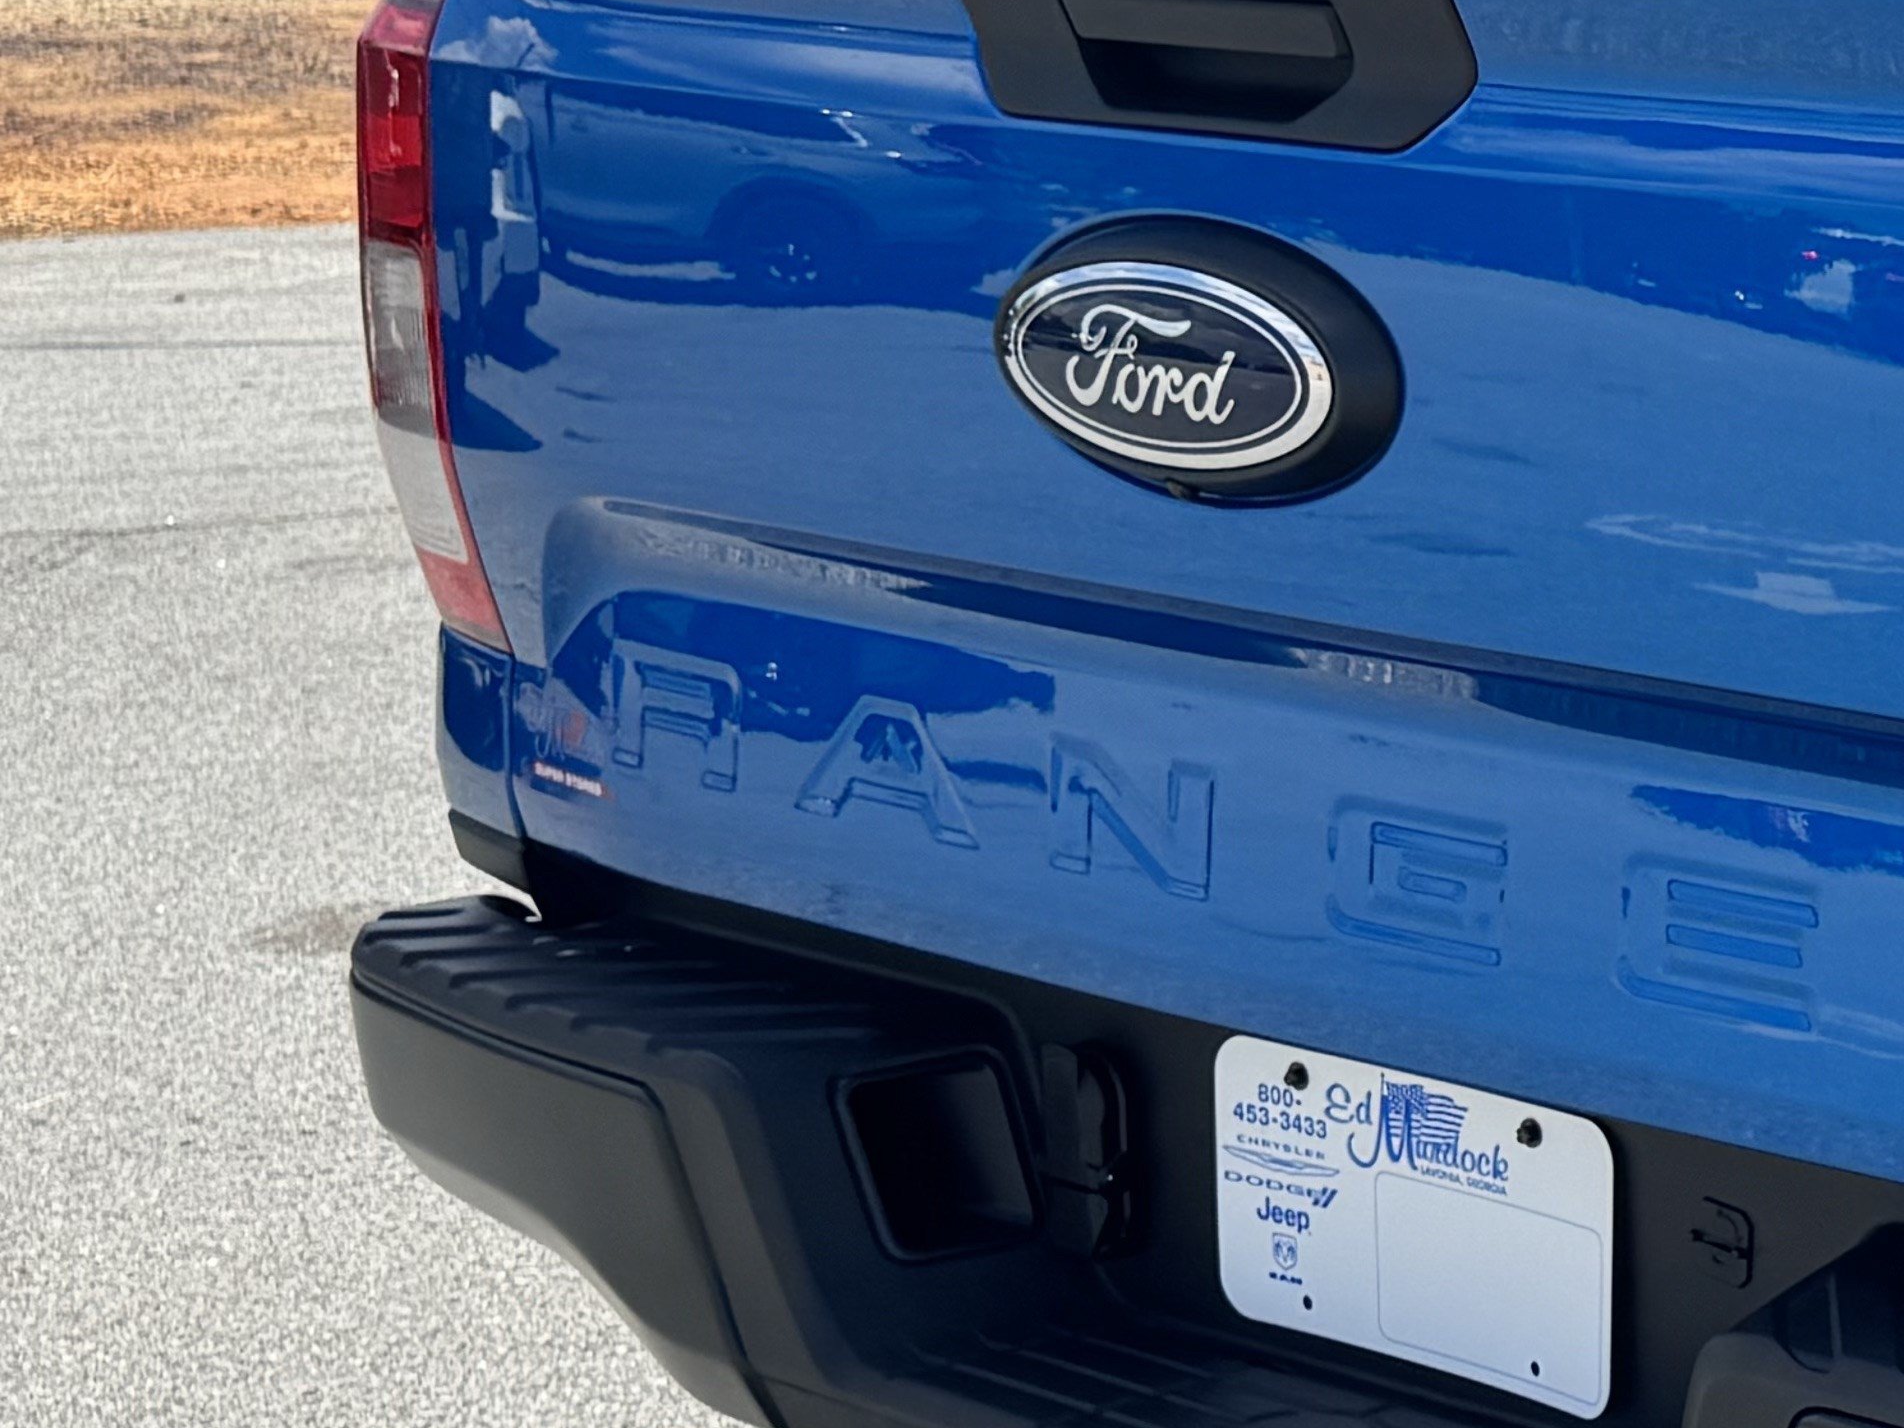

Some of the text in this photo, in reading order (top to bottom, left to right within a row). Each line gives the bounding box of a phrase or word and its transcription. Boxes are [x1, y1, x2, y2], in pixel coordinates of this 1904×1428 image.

[1065, 303, 1236, 425] Ford
[1257, 1082, 1303, 1108] 800-
[1232, 1101, 1328, 1139] 453-3433
[1324, 1075, 1509, 1181] Ed Murdock
[1237, 1133, 1326, 1160] CHRYSLER
[1256, 1195, 1311, 1234] Jeep
